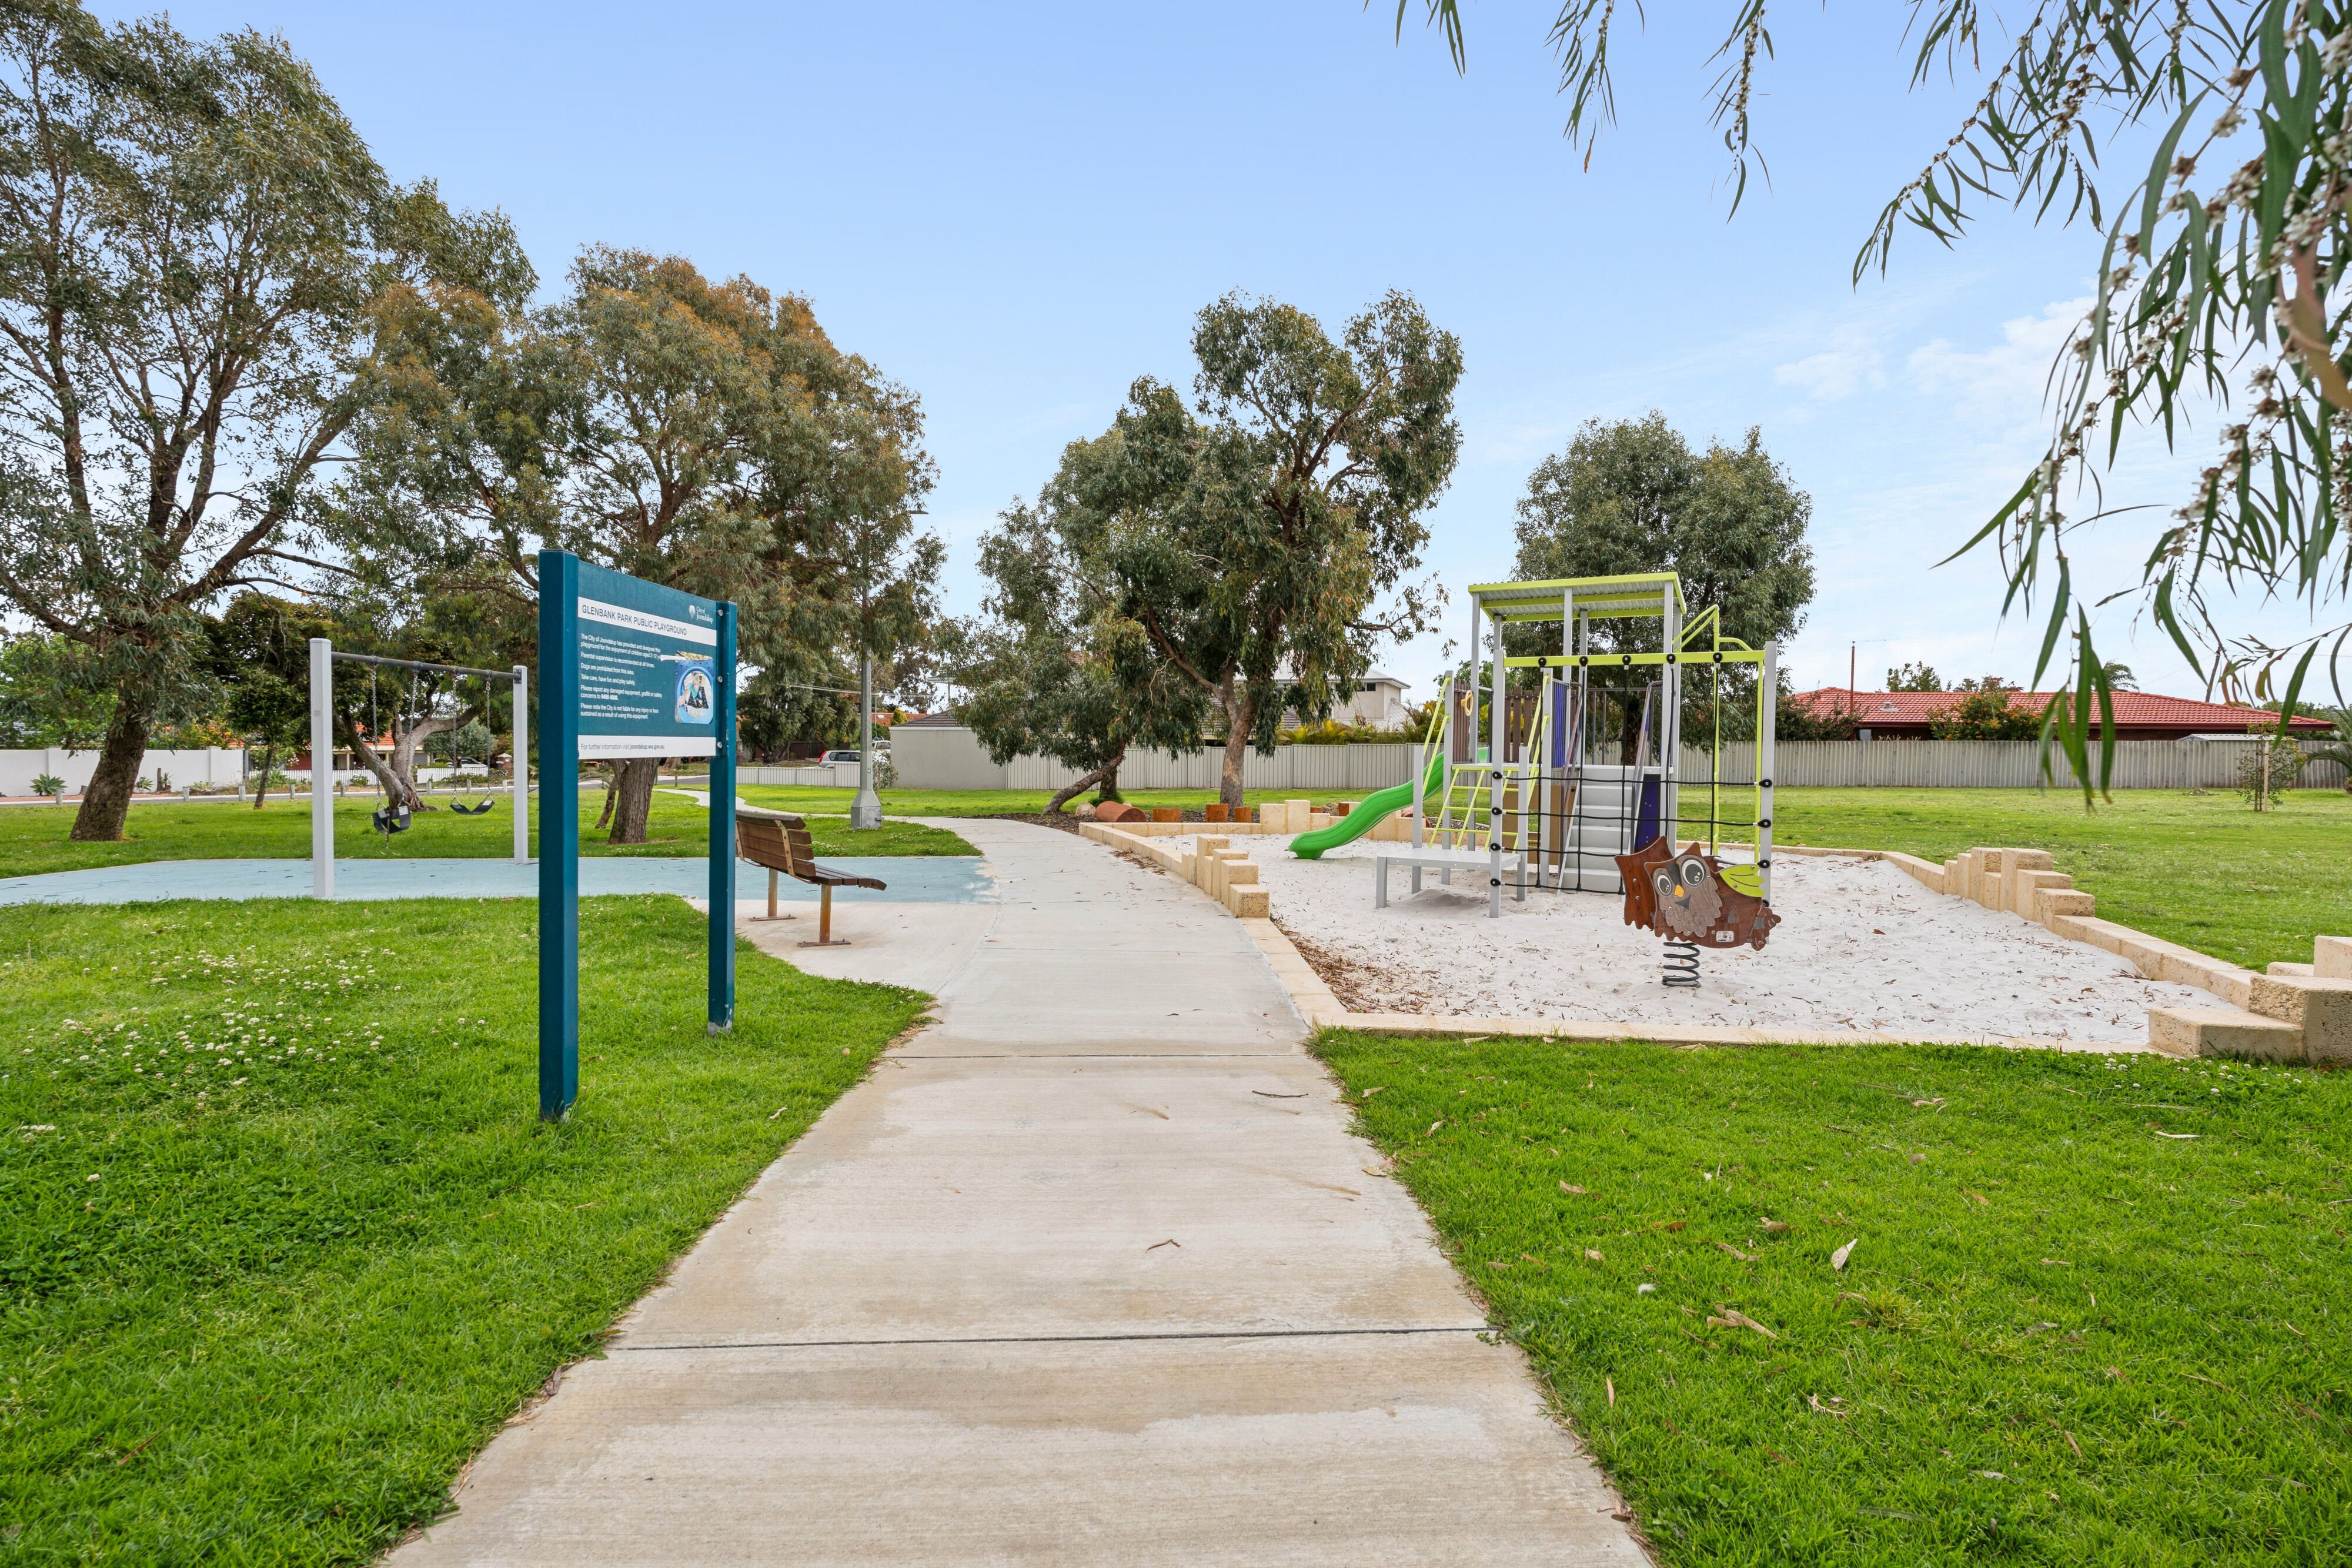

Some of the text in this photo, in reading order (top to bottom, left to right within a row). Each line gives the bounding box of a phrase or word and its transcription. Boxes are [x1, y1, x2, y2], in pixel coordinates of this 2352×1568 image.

[582, 605, 687, 635] GLENBANK PARK PUBLIC PLAYGROUND
[696, 612, 713, 624] Joondalup
[600, 637, 616, 646] Joondalup
